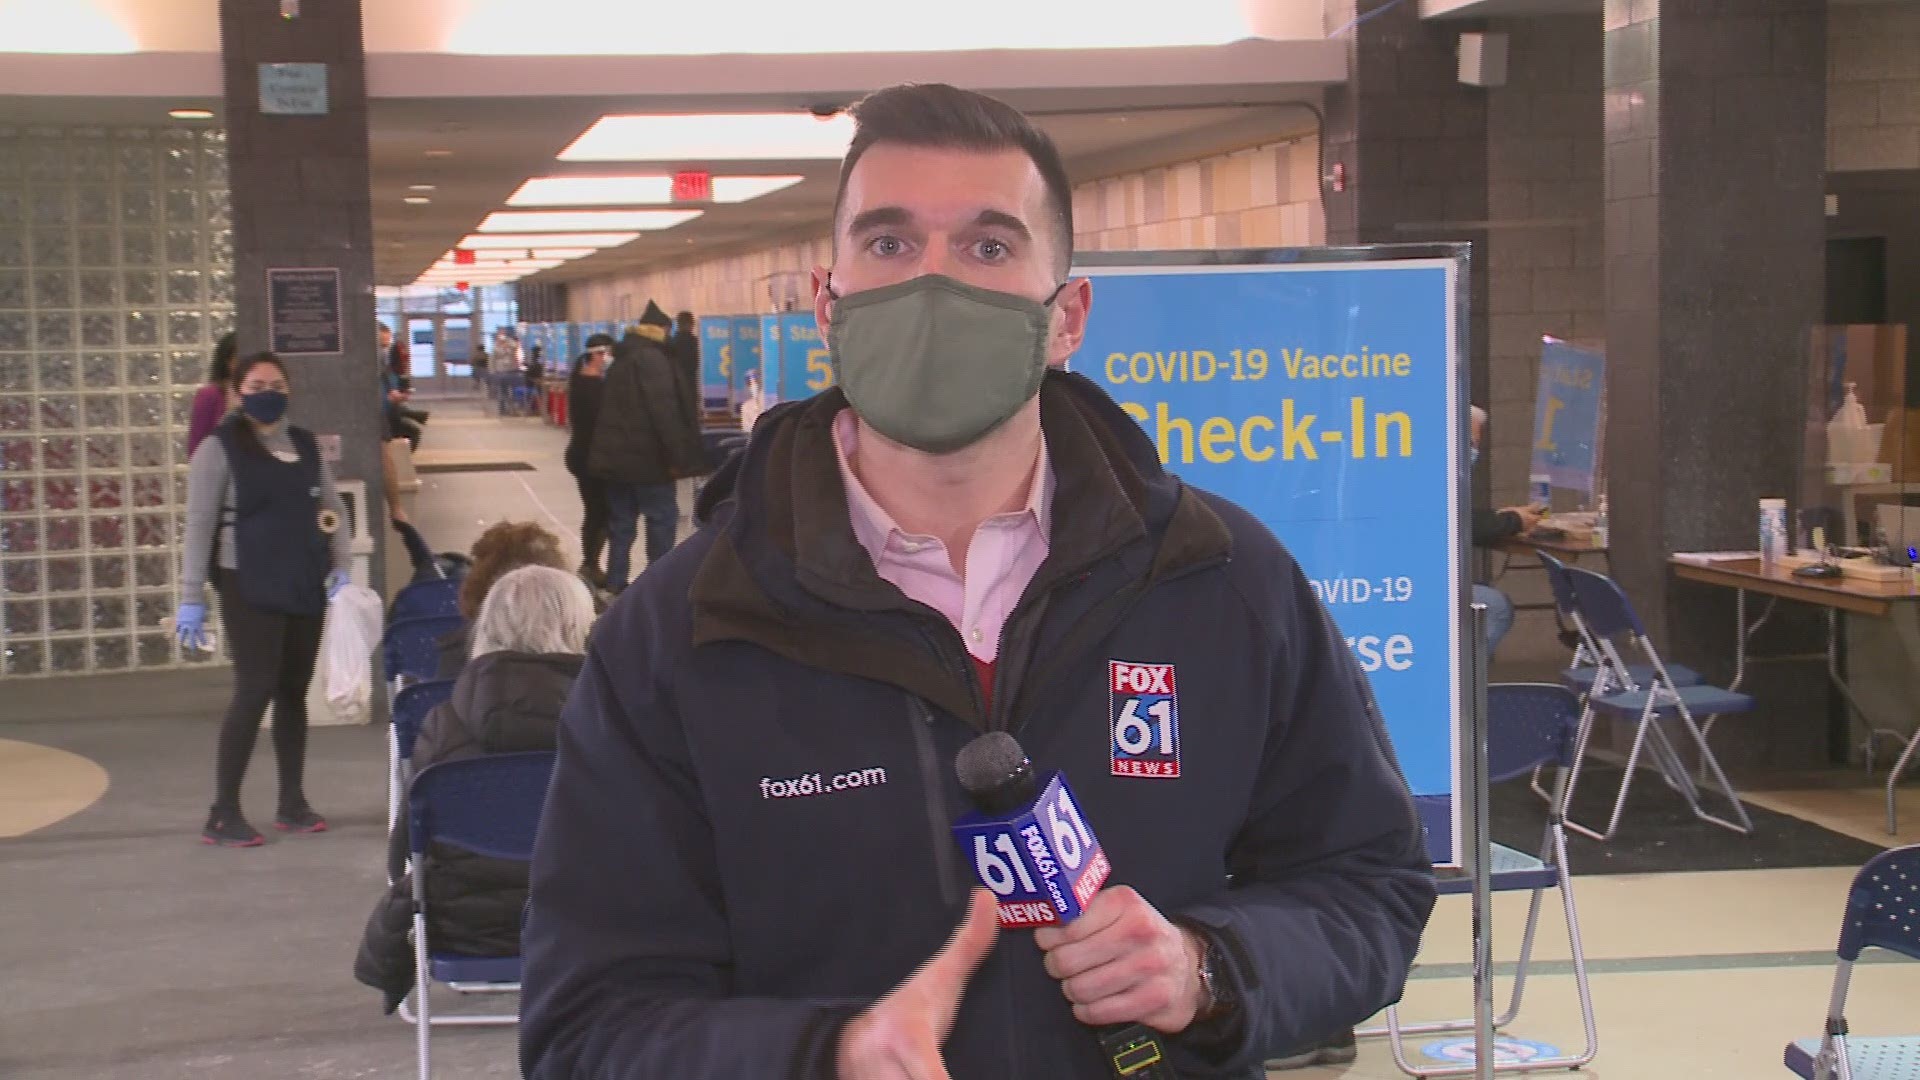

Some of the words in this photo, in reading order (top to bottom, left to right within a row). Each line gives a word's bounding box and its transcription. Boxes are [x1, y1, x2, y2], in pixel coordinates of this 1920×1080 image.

[805, 348, 833, 391] 5
[1104, 348, 1269, 385] COVID-19
[1281, 345, 1412, 379] Vaccine
[1309, 576, 1413, 605] OVID-19
[1114, 664, 1171, 694] FOX
[1114, 698, 1174, 756] 61
[758, 765, 888, 800] fox61.com
[1117, 760, 1174, 776] NEWS
[1047, 785, 1093, 870] 61
[973, 833, 1038, 896] 61
[1075, 852, 1110, 907] NEWS
[996, 902, 1056, 925] NEWS
